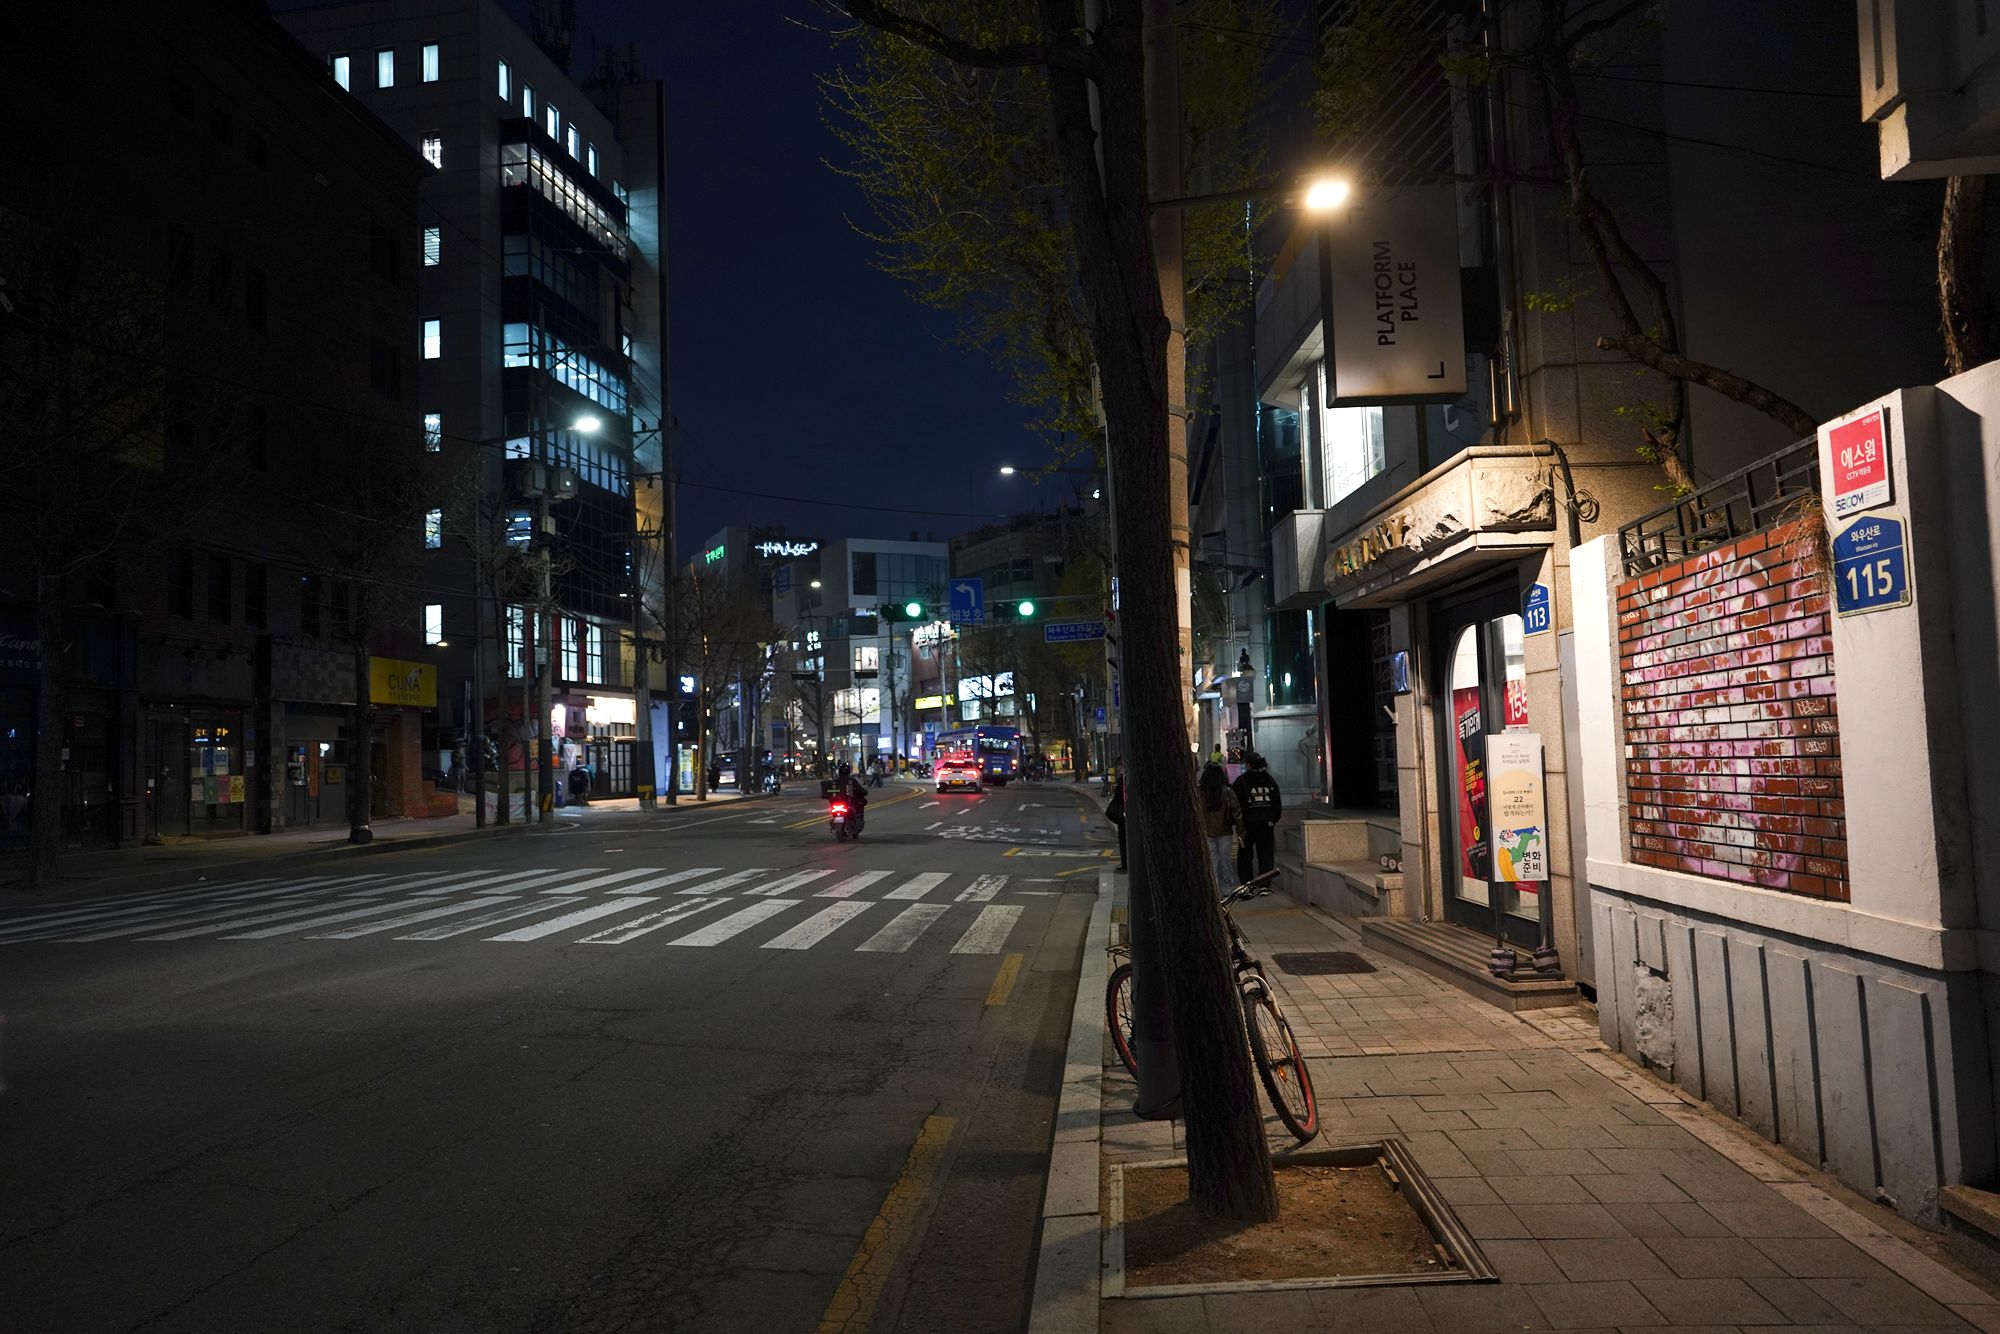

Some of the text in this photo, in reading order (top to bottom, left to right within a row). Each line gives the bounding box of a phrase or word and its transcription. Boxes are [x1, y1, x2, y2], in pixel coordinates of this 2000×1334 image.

[1373, 240, 1395, 345] PLATFORM
[1398, 261, 1418, 321] PLACE
[1840, 438, 1876, 468] 에스원
[1846, 470, 1859, 481] CCTV
[1836, 492, 1865, 512] SECOM
[1850, 524, 1881, 542] 와우산로
[1846, 558, 1893, 600] 115
[951, 608, 984, 621] 비보호
[1527, 607, 1546, 629] 113
[388, 674, 420, 692] CUNA
[1513, 795, 1524, 803] 고2
[1522, 851, 1541, 862] 변화
[1522, 862, 1541, 874] 준비
